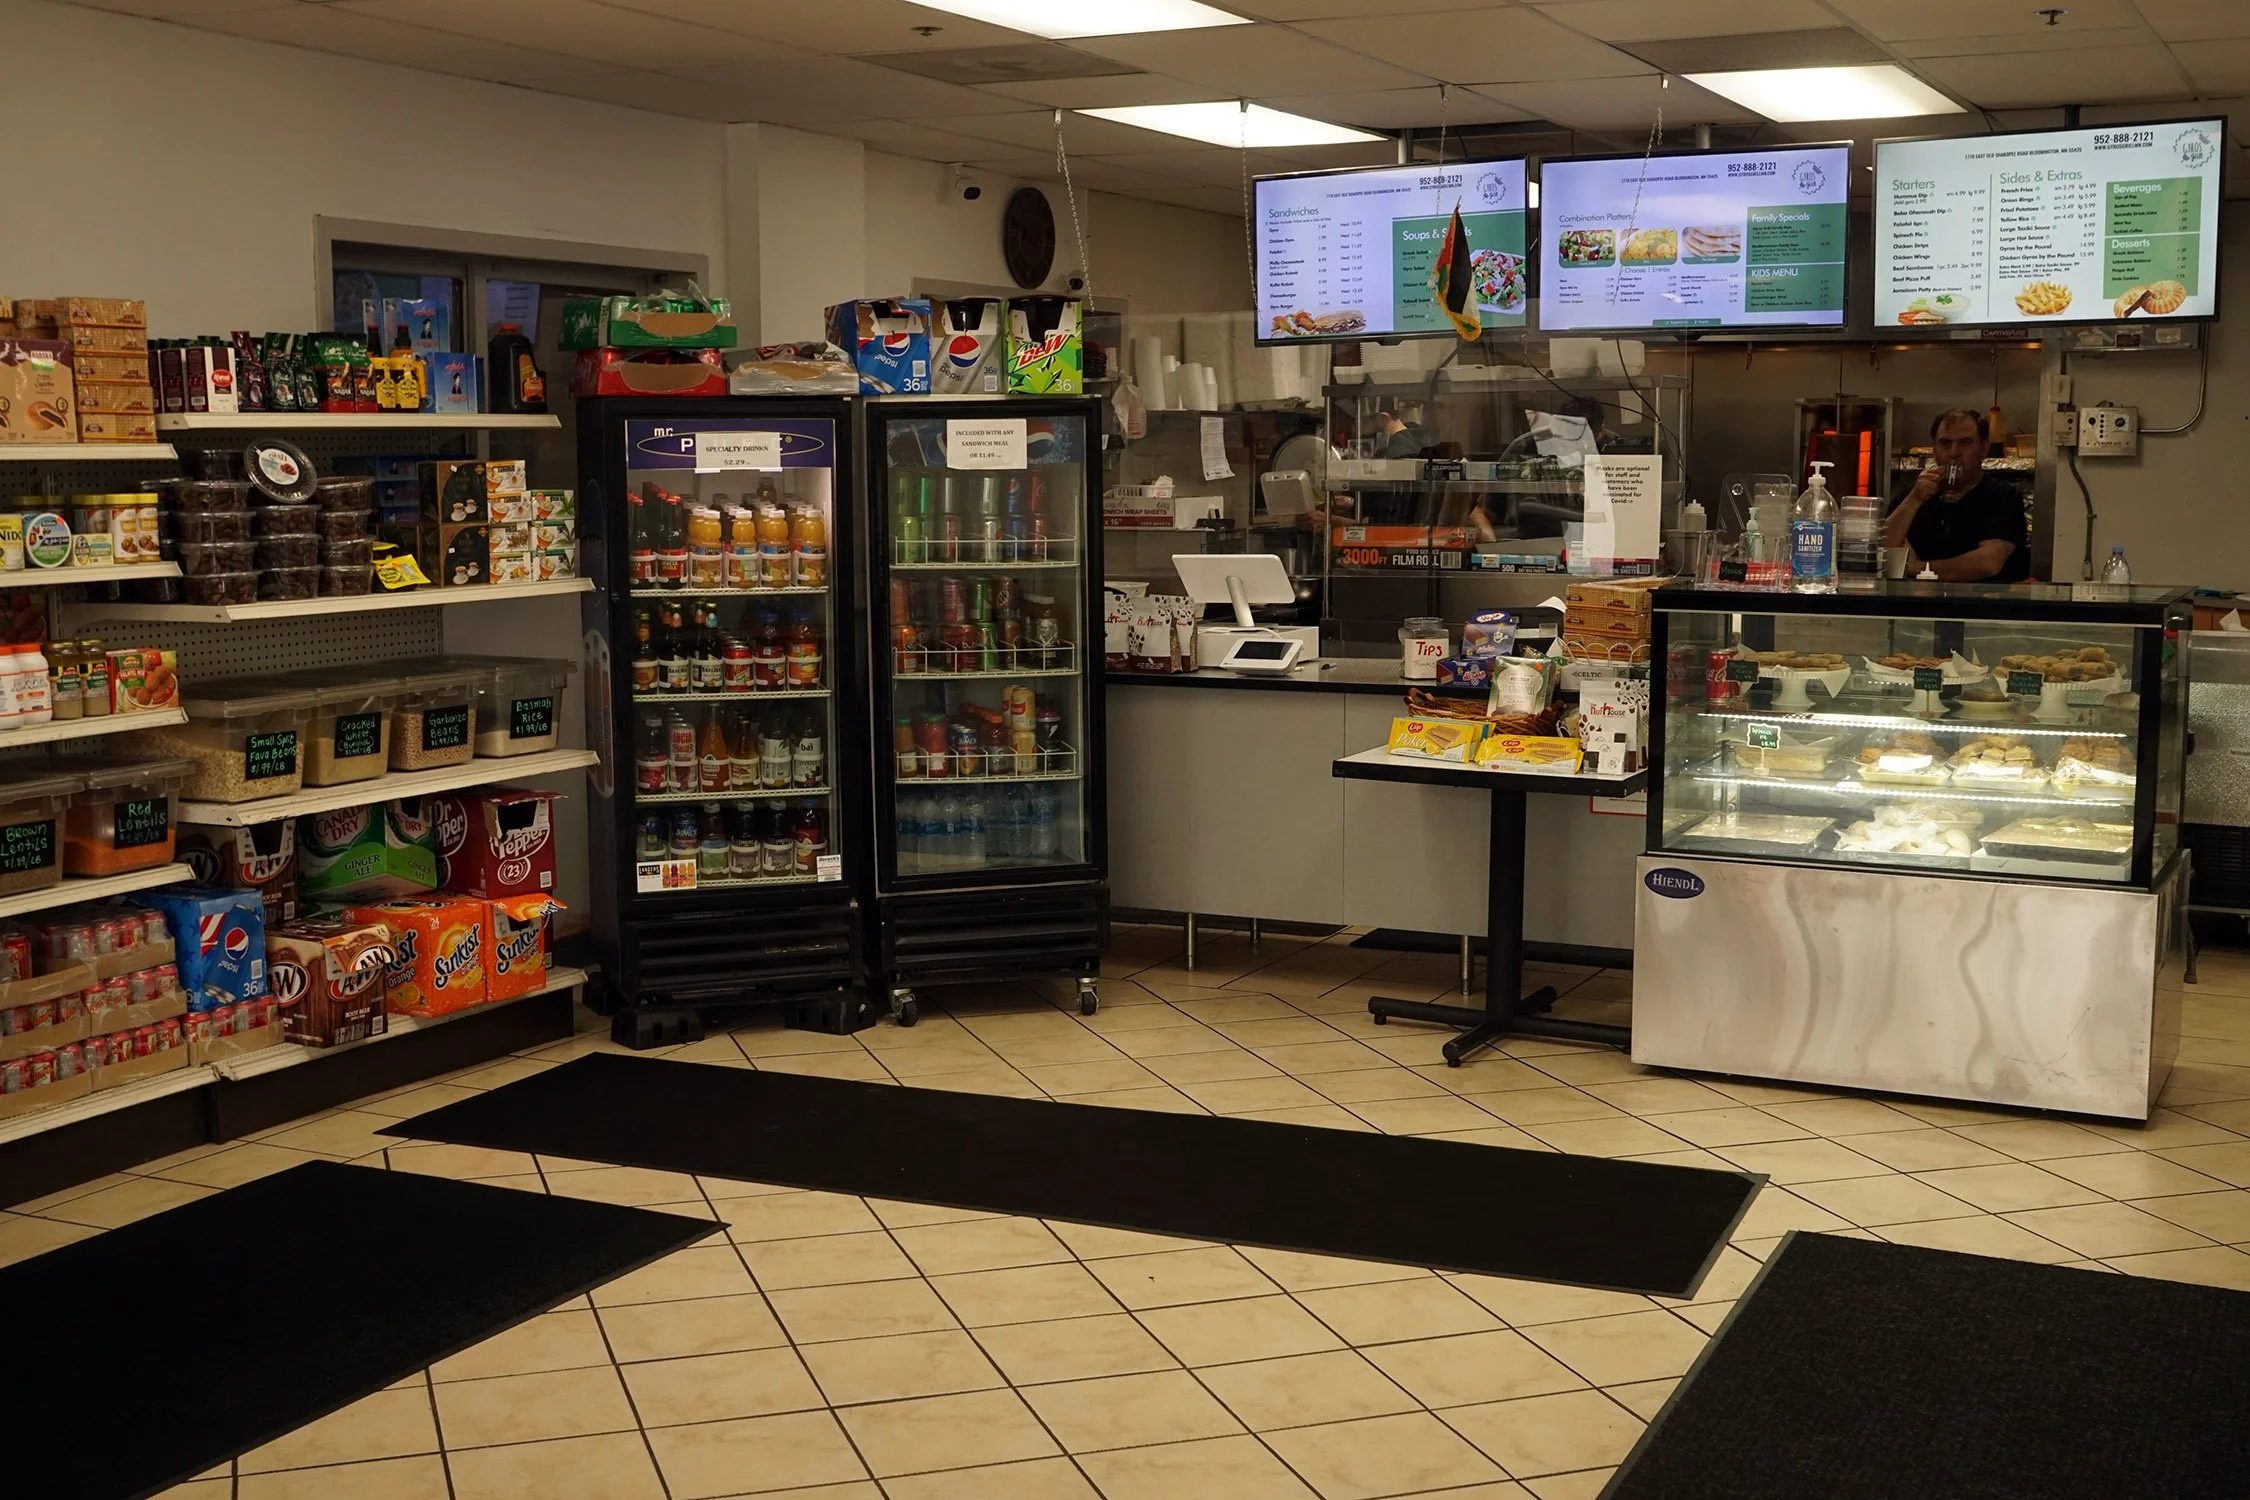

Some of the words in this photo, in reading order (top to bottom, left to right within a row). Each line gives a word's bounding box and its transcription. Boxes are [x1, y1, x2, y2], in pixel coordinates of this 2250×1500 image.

[2094, 132, 2153, 144] 952-888-2121
[1728, 162, 1776, 172] 952-888-2121
[1419, 175, 1463, 185] 952-888-2121
[2000, 172, 2030, 184] Sides
[2034, 171, 2043, 182] &
[2048, 170, 2082, 181] Extras
[1893, 180, 1935, 191] Starters
[2114, 184, 2161, 193] Beverages
[1269, 207, 1319, 218] Sandwiches
[1559, 215, 1605, 223] Combination
[1752, 214, 1778, 223] Family
[1779, 212, 1810, 222] Specials
[1403, 230, 1430, 241] Soups
[1432, 229, 1439, 238] &
[2112, 239, 2150, 248] Desserts
[1752, 269, 1770, 277] KIDS
[1772, 268, 1798, 276] MENU
[874, 354, 899, 368] pepsi
[903, 379, 921, 391] 36
[938, 365, 965, 382] pepsi
[983, 366, 993, 375] 36
[1055, 379, 1072, 391] 36
[1798, 535, 1823, 545] HAND
[1392, 555, 1415, 566] FILM
[1416, 641, 1442, 657] Tips
[522, 712, 543, 722] Rice
[341, 717, 375, 731] Cracked
[430, 725, 459, 738] Beans
[251, 736, 274, 748] Small
[277, 734, 295, 746] Split
[801, 743, 813, 751] bai
[250, 751, 269, 762] Fava
[272, 746, 296, 758] Beans
[128, 801, 151, 817] Red
[118, 812, 166, 832] Lentils
[332, 819, 358, 841] DRY
[0, 837, 48, 856] Lentils
[344, 854, 380, 871] GINGER
[408, 859, 431, 873] GINGER
[354, 866, 372, 878] ALE
[414, 870, 426, 880] ALE
[507, 863, 520, 878] 23
[1653, 873, 1699, 890] HIENDL
[434, 925, 481, 990] Sunkist
[218, 960, 240, 974] pepsi
[243, 982, 257, 996] 36
[388, 967, 416, 988] Orange
